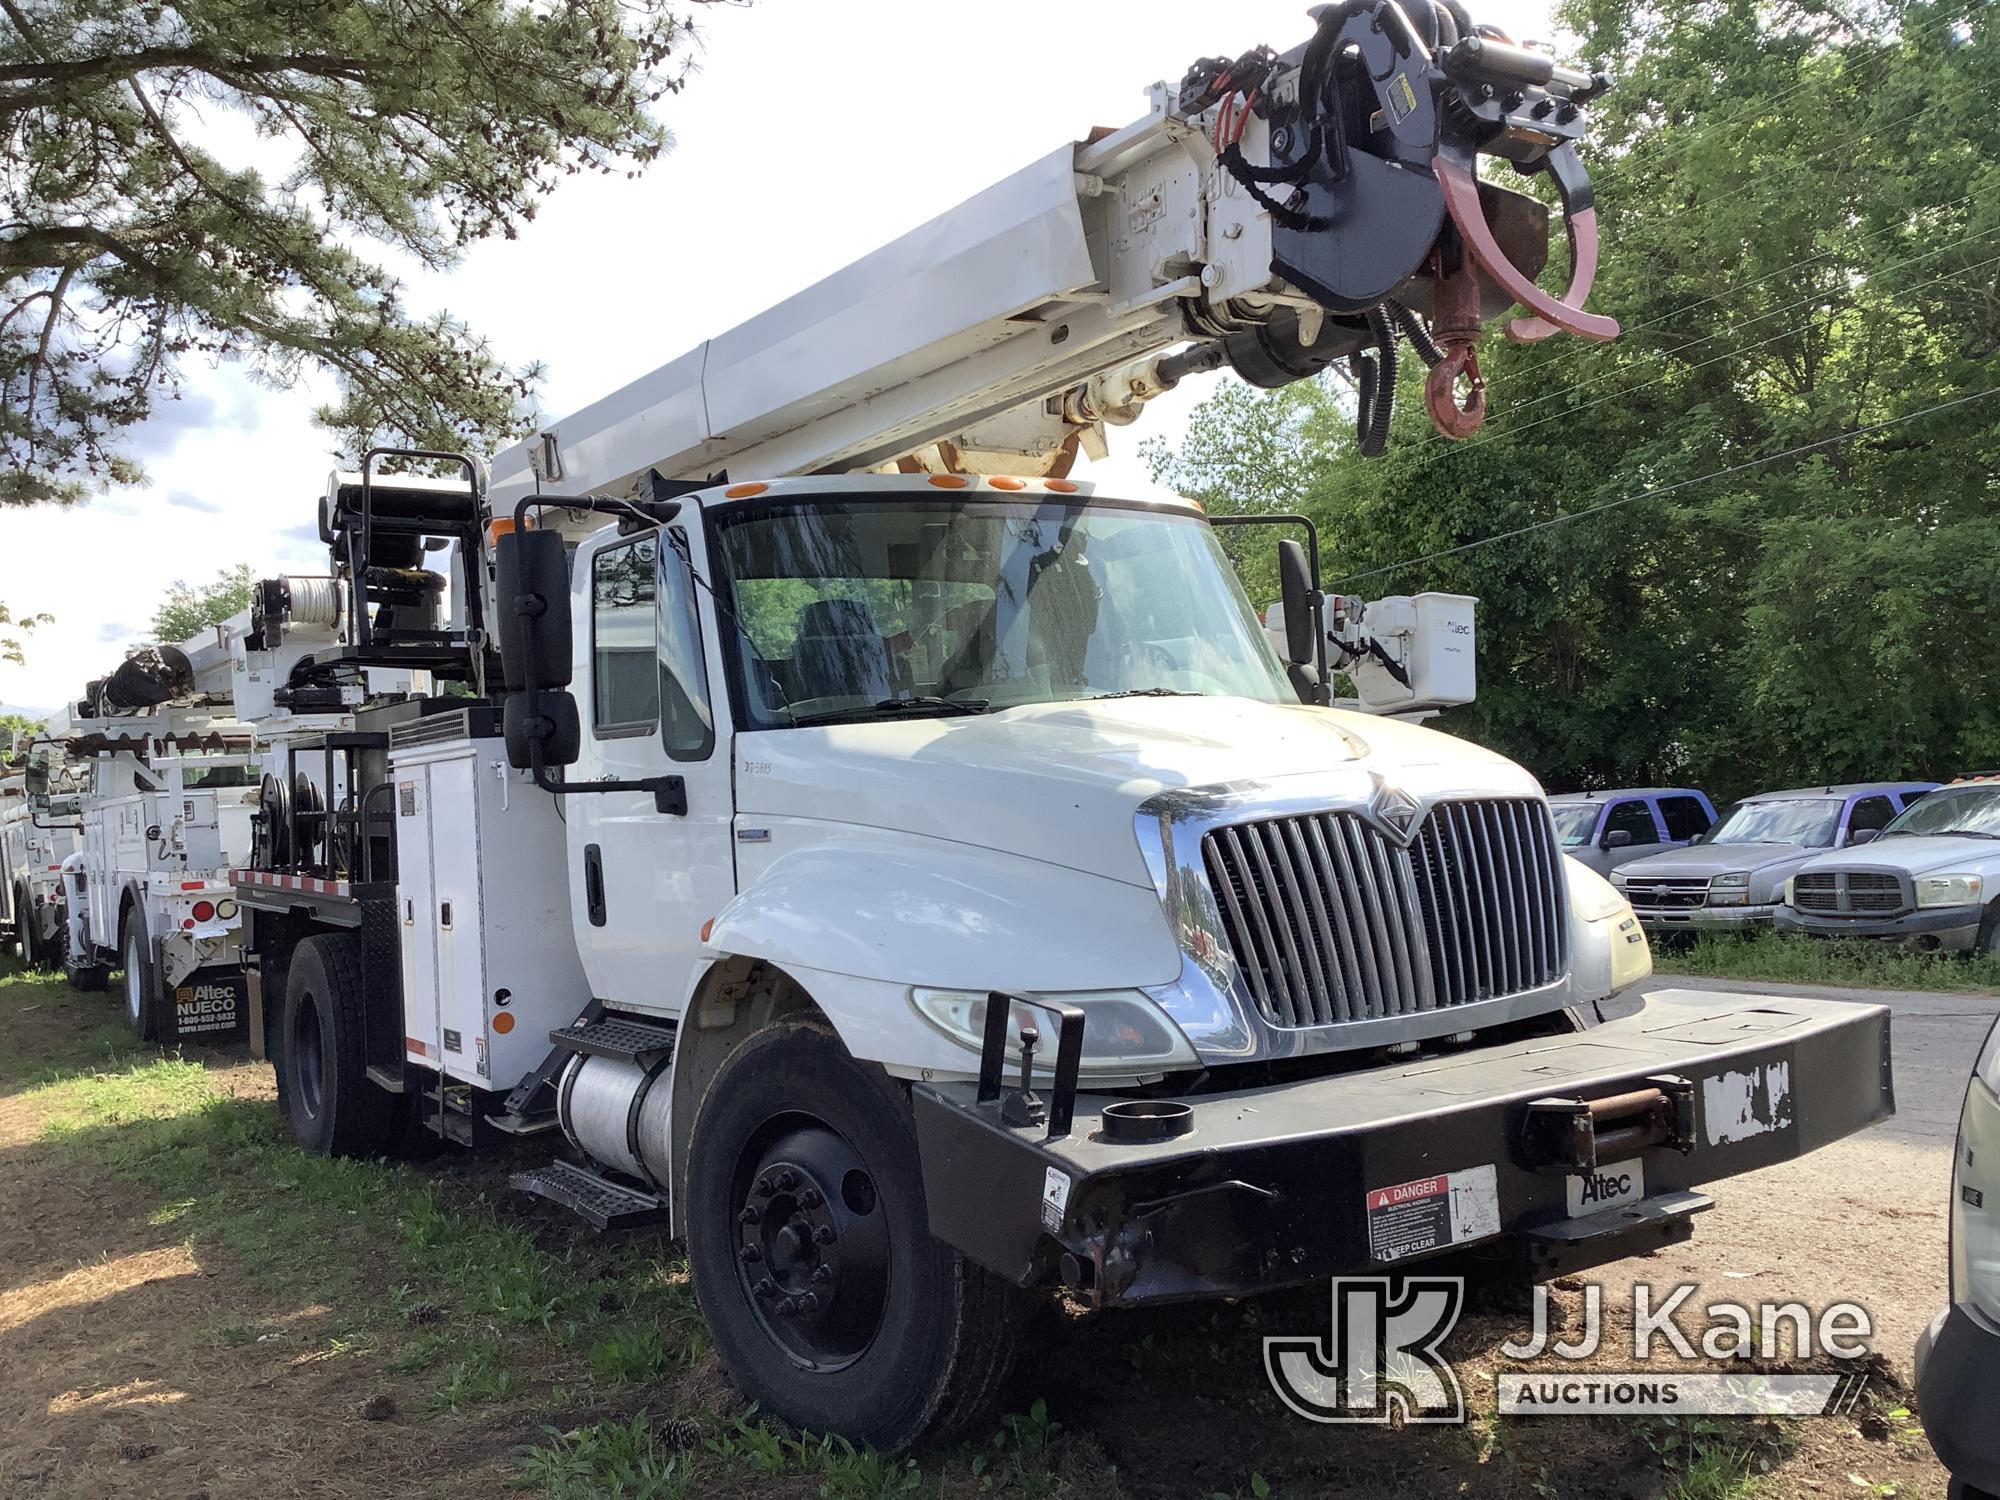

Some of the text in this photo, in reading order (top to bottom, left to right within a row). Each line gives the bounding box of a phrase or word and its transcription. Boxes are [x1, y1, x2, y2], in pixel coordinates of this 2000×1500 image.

[193, 985, 236, 1001] Altec
[177, 998, 236, 1016] NUECO
[1394, 1180, 1438, 1201] DANGER
[1581, 1173, 1632, 1206] Altec
[1411, 1238, 1436, 1252] CLEAR
